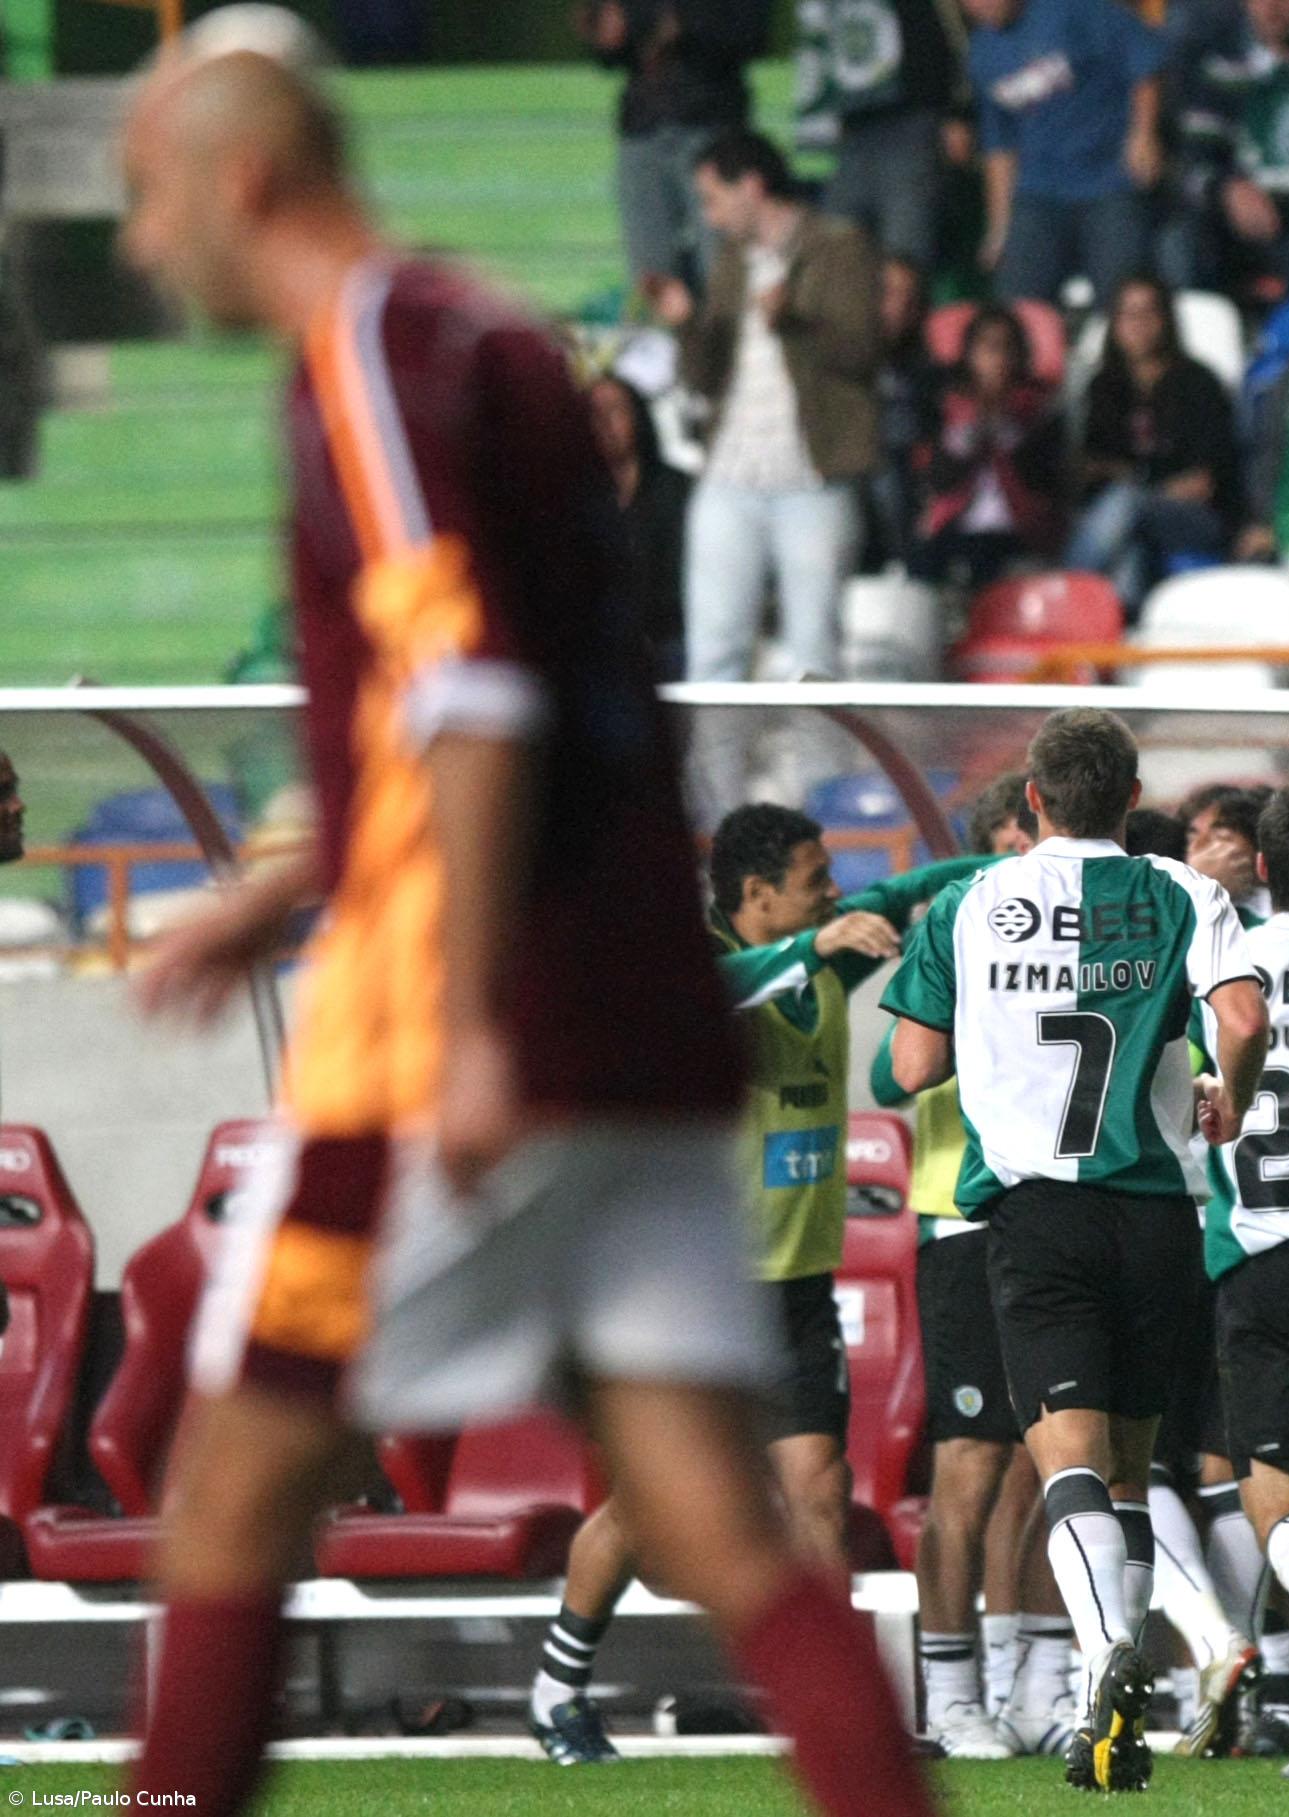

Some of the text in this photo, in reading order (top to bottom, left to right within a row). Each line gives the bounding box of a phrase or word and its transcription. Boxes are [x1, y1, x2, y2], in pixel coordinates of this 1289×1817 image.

[1052, 904, 1159, 943] BES
[988, 959, 1156, 993] IZMAILOV
[1036, 1011, 1116, 1160] 7
